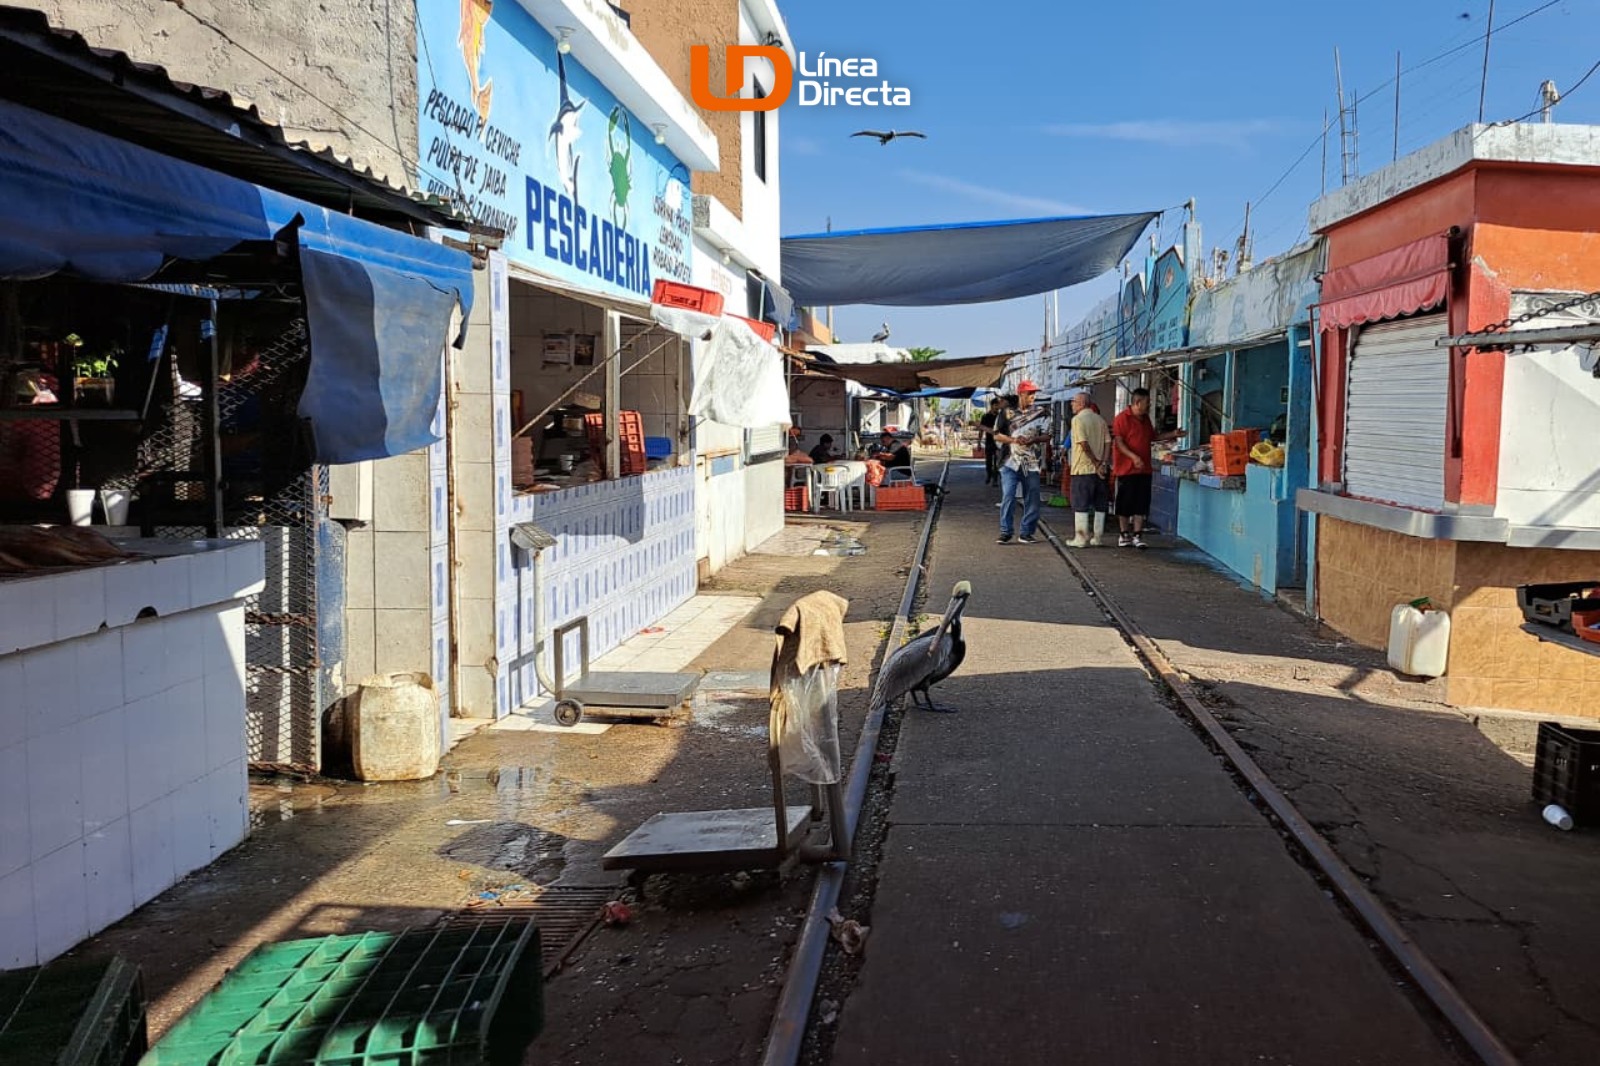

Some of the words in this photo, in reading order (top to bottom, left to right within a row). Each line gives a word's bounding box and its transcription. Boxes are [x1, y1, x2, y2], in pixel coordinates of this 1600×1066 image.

[424, 88, 475, 139] PESCADO
[485, 125, 521, 167] CEVICHE
[464, 154, 479, 184] DE
[479, 162, 507, 200] JAIBA
[526, 174, 652, 298] PESCADERIA
